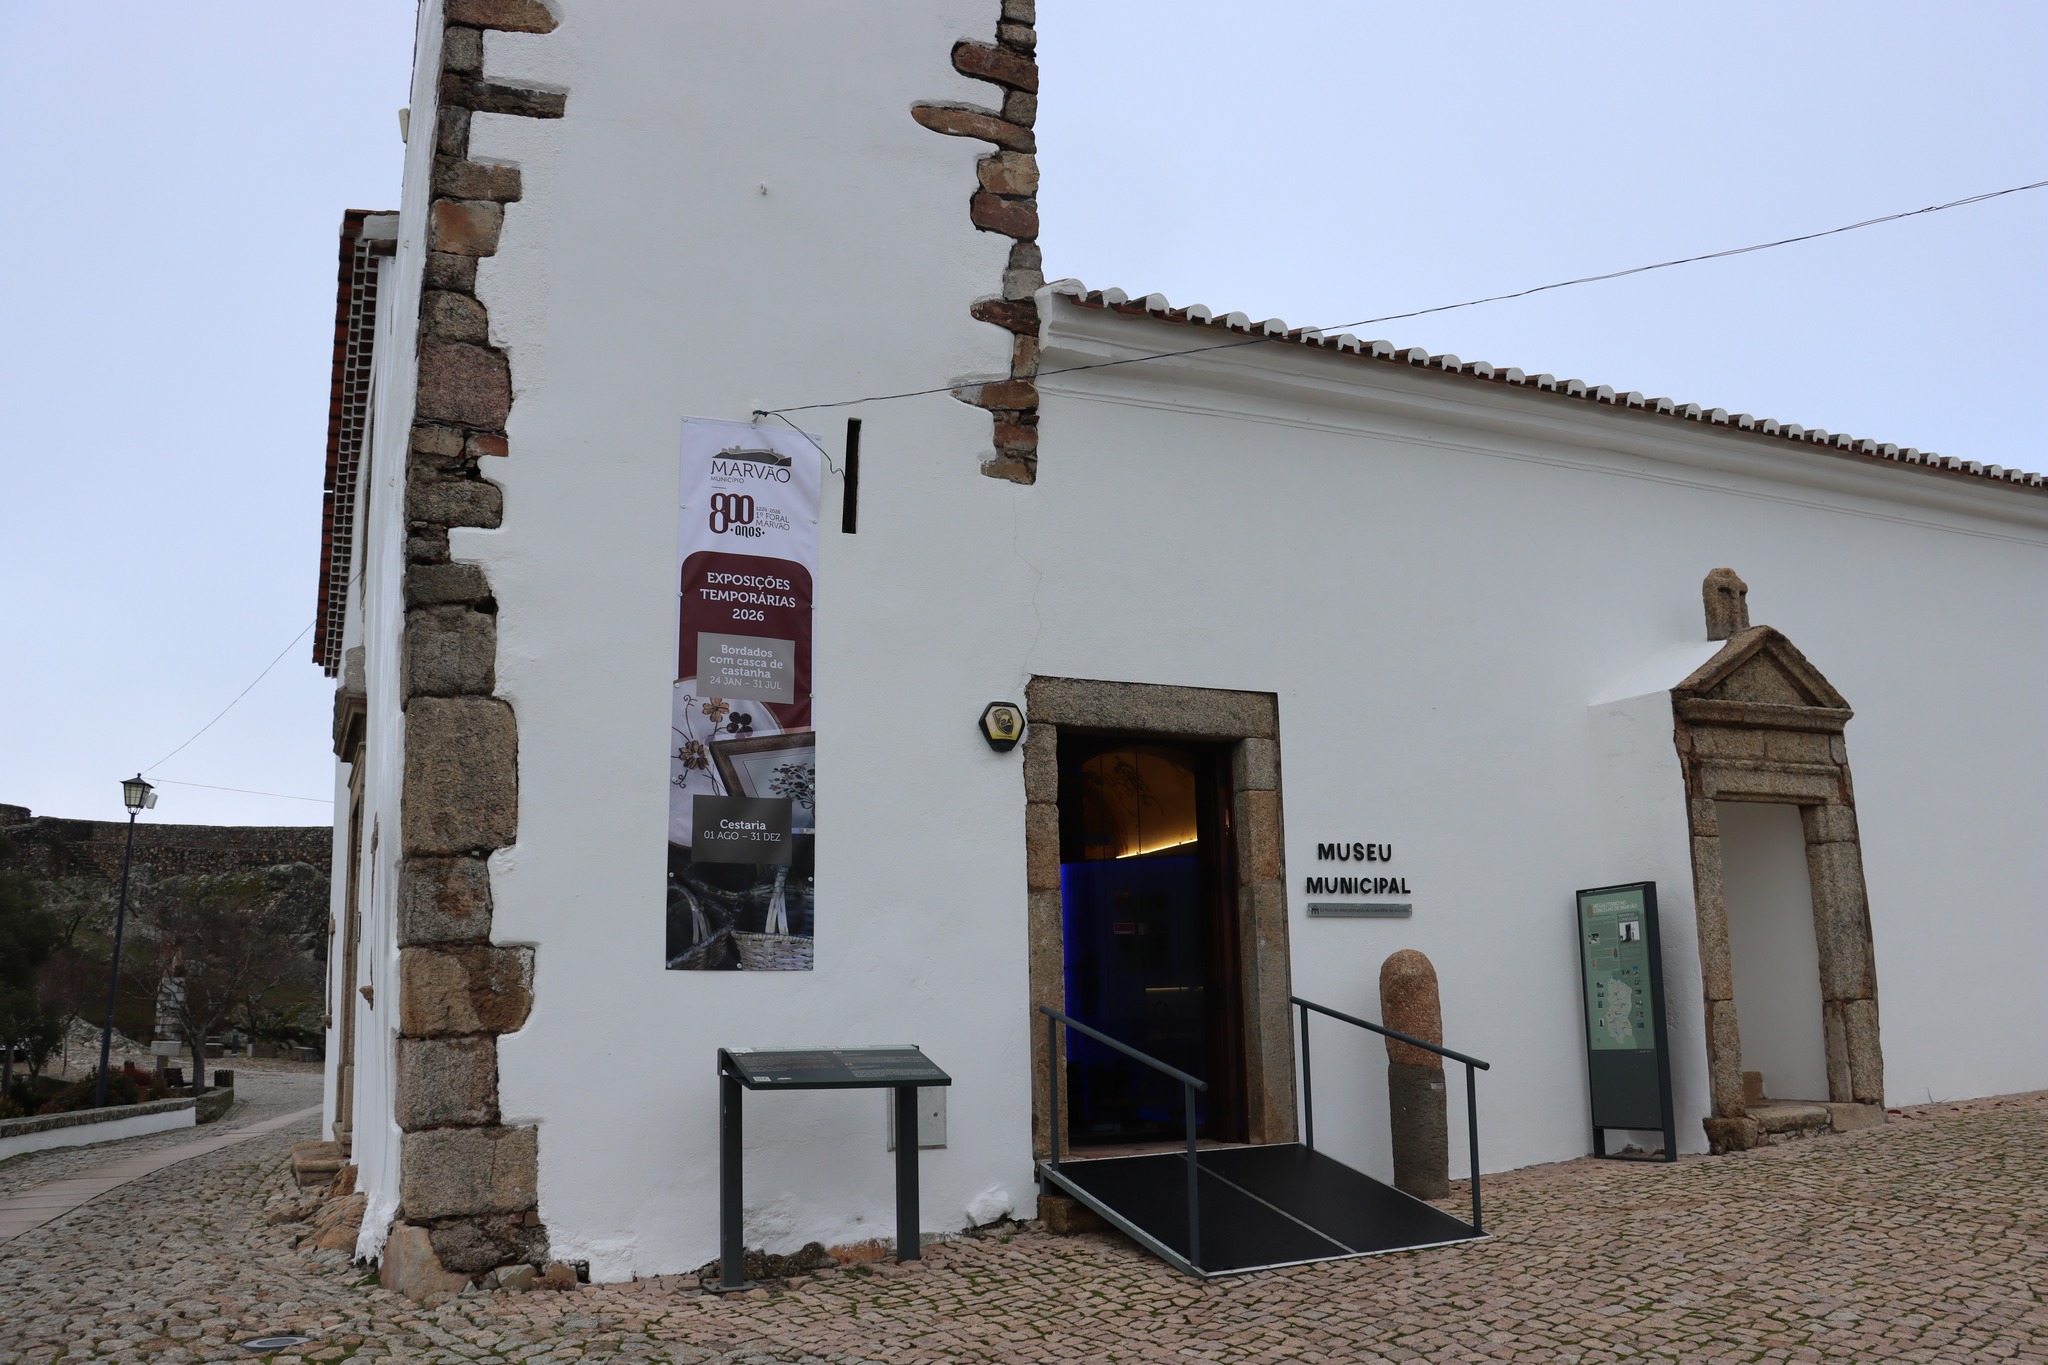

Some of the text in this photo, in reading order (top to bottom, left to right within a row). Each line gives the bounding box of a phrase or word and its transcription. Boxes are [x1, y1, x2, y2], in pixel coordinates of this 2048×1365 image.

[710, 460, 791, 483] MARVÃO
[709, 492, 755, 534] 800
[765, 513, 790, 524] FORAL
[706, 572, 791, 591] EXPOSIÇÕES
[700, 589, 796, 608] TEMPORÁRIAS
[732, 608, 765, 621] 2026
[721, 645, 773, 658] Bordados
[709, 656, 784, 669] com casca de
[721, 667, 771, 679] castanha
[709, 676, 721, 685] 24
[723, 677, 742, 687] JAN
[753, 680, 763, 688] 31
[764, 681, 782, 690] JUL
[719, 819, 767, 831] Cestaria
[704, 831, 715, 840] 01
[716, 831, 739, 840] AGO
[751, 831, 761, 841] 31
[764, 833, 781, 842] DEZ
[1317, 842, 1392, 862] MUSEU
[1306, 877, 1411, 895] MUNICIPAL
